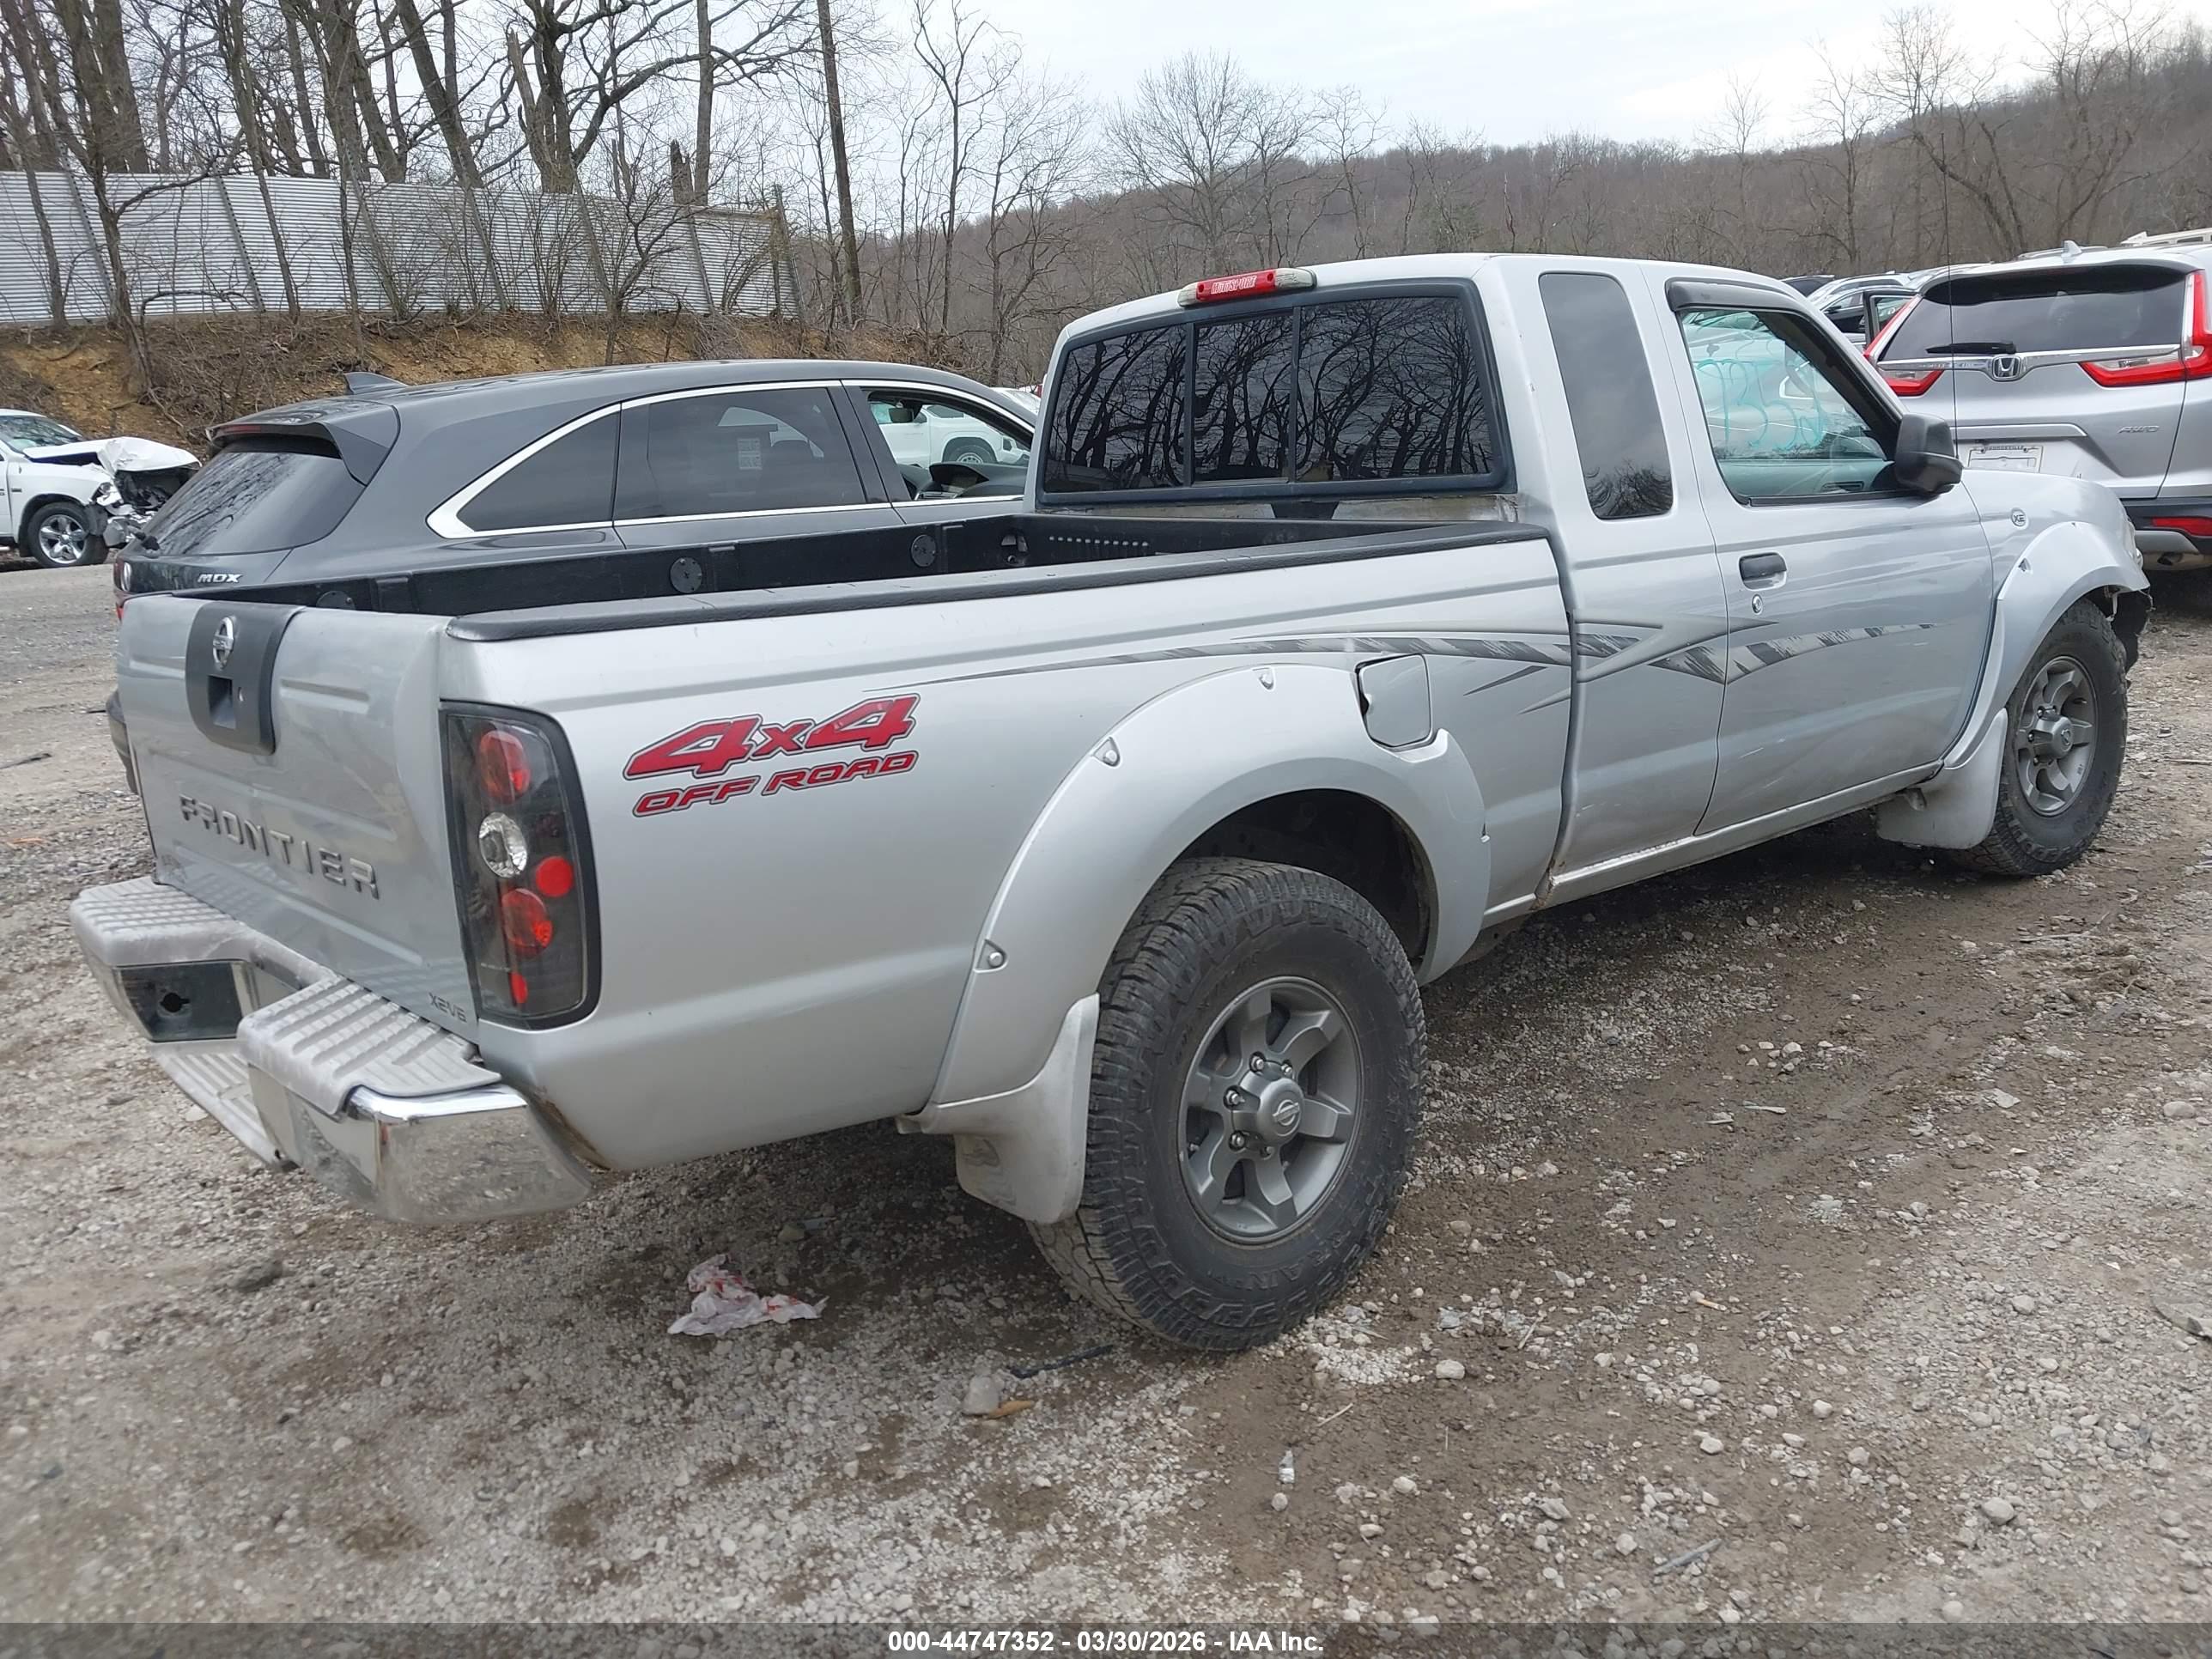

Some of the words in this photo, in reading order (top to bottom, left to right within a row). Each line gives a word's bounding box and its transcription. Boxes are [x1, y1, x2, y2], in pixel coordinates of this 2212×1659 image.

[2117, 425, 2160, 434] AWD
[2013, 514, 2026, 523] XE
[198, 573, 243, 583] MDX
[633, 775, 761, 817] OFF
[761, 750, 920, 795] ROAD
[179, 793, 380, 900] FRONTIER
